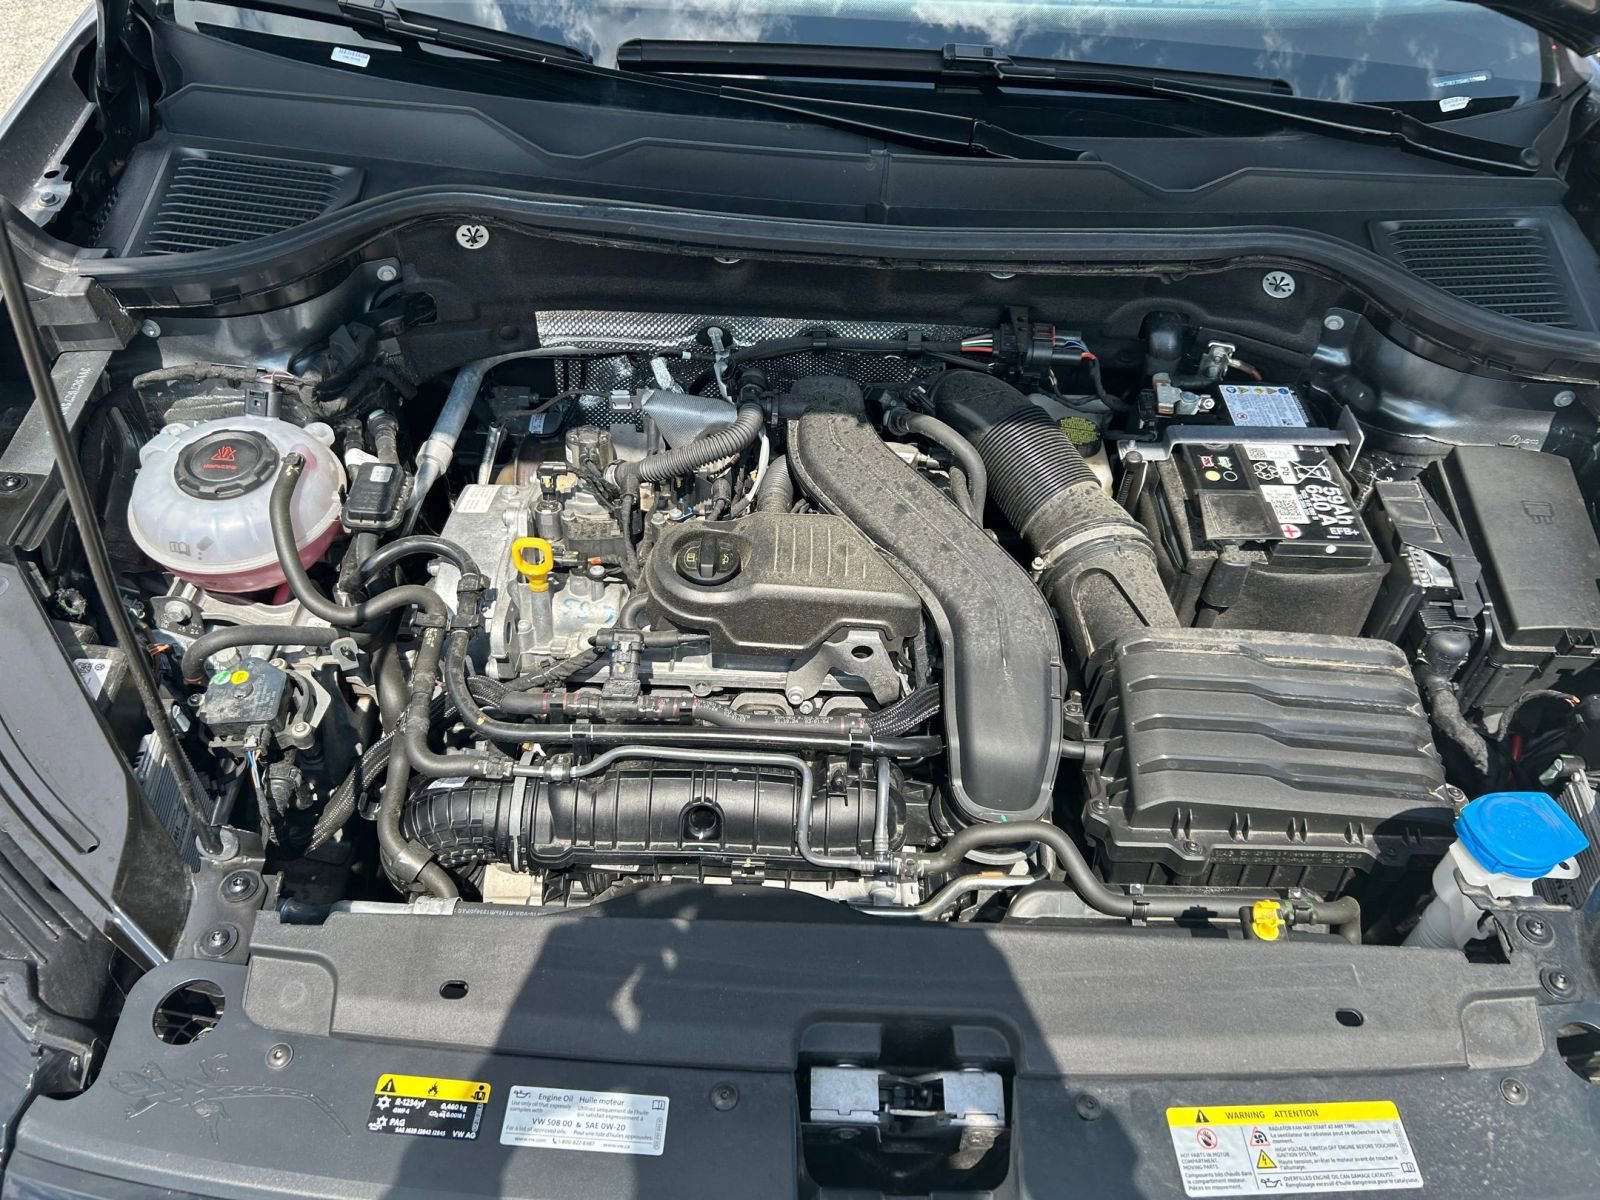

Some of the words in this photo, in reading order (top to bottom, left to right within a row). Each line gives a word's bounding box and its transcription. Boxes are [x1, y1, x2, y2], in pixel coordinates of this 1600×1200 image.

[1305, 484, 1332, 512] 640
[1323, 486, 1355, 525] 59Ah
[1329, 527, 1360, 536] EFB+
[538, 1093, 562, 1102] Engine
[579, 1096, 598, 1104] Huile
[1225, 1111, 1265, 1120] WARNING
[1274, 1110, 1319, 1118] ATTENTION
[389, 1118, 406, 1126] PAG
[600, 1122, 626, 1131] 0W-20
